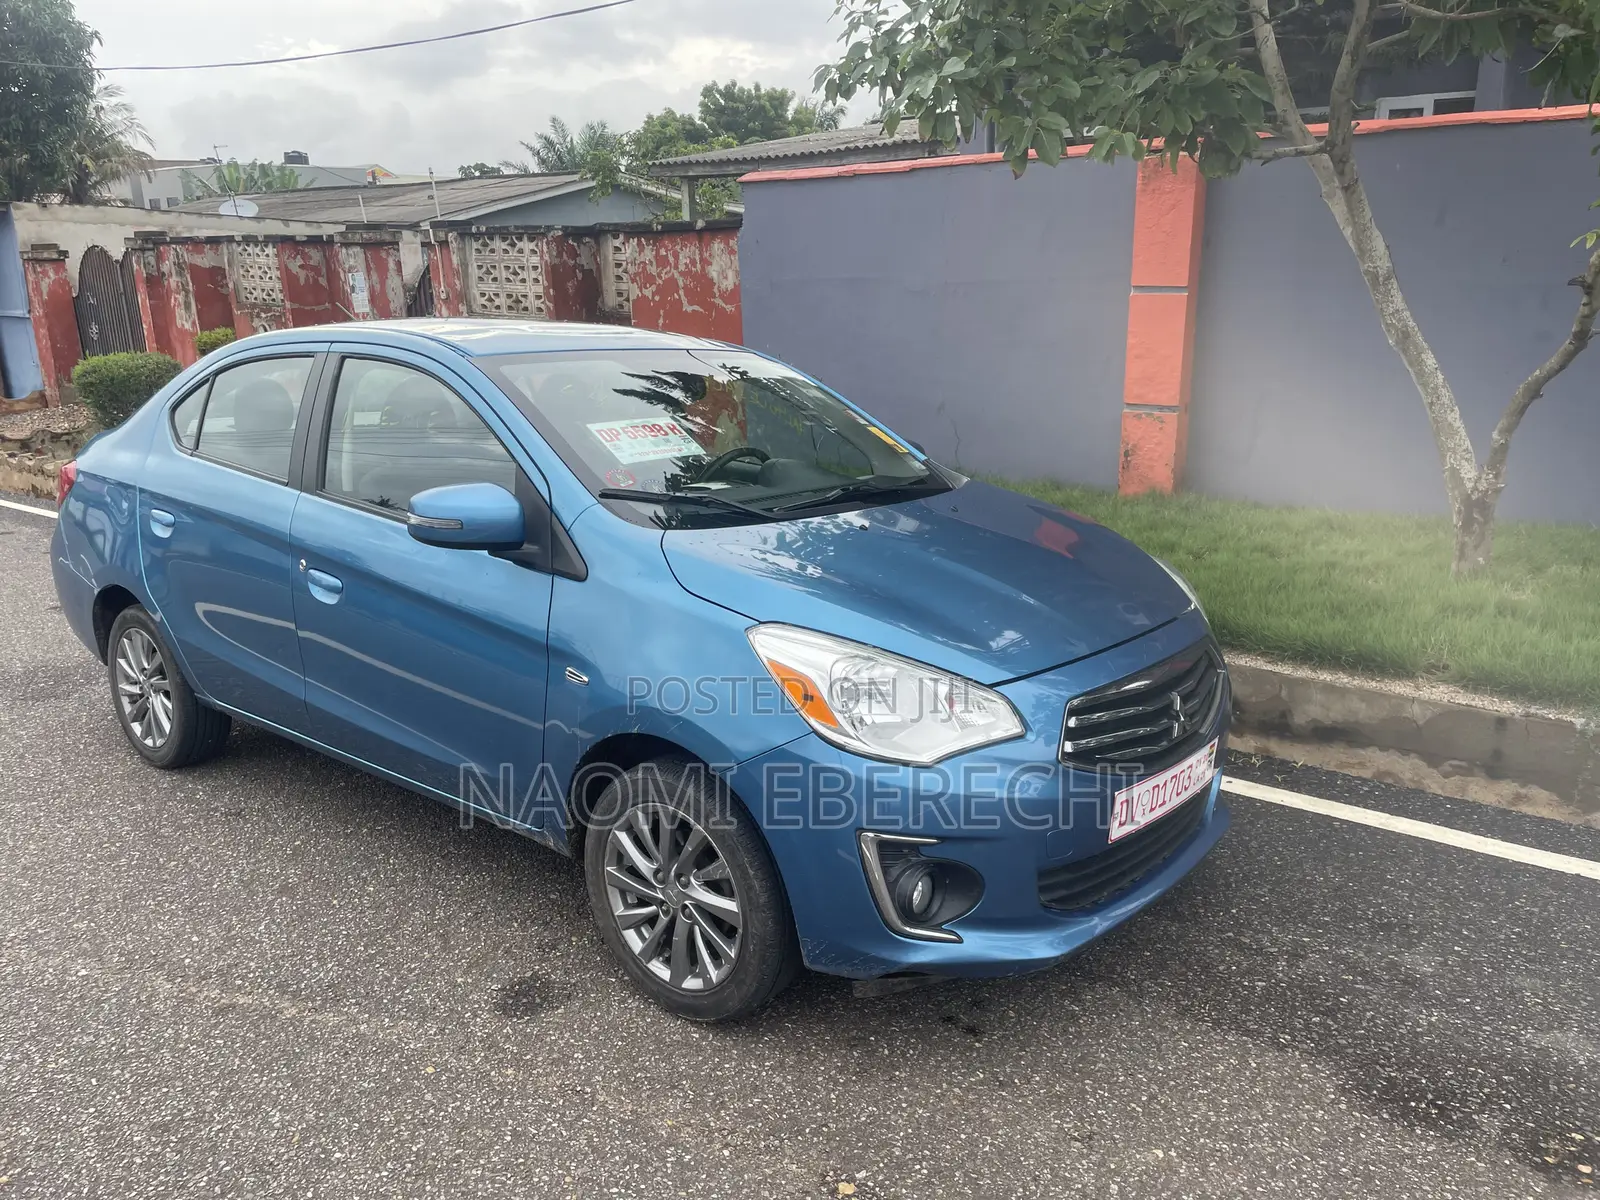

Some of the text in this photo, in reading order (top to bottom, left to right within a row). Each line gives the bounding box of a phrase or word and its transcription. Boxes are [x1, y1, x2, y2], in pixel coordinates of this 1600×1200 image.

[594, 427, 622, 443] DP
[620, 423, 670, 440] 5598
[1117, 763, 1194, 829] DV D1703
